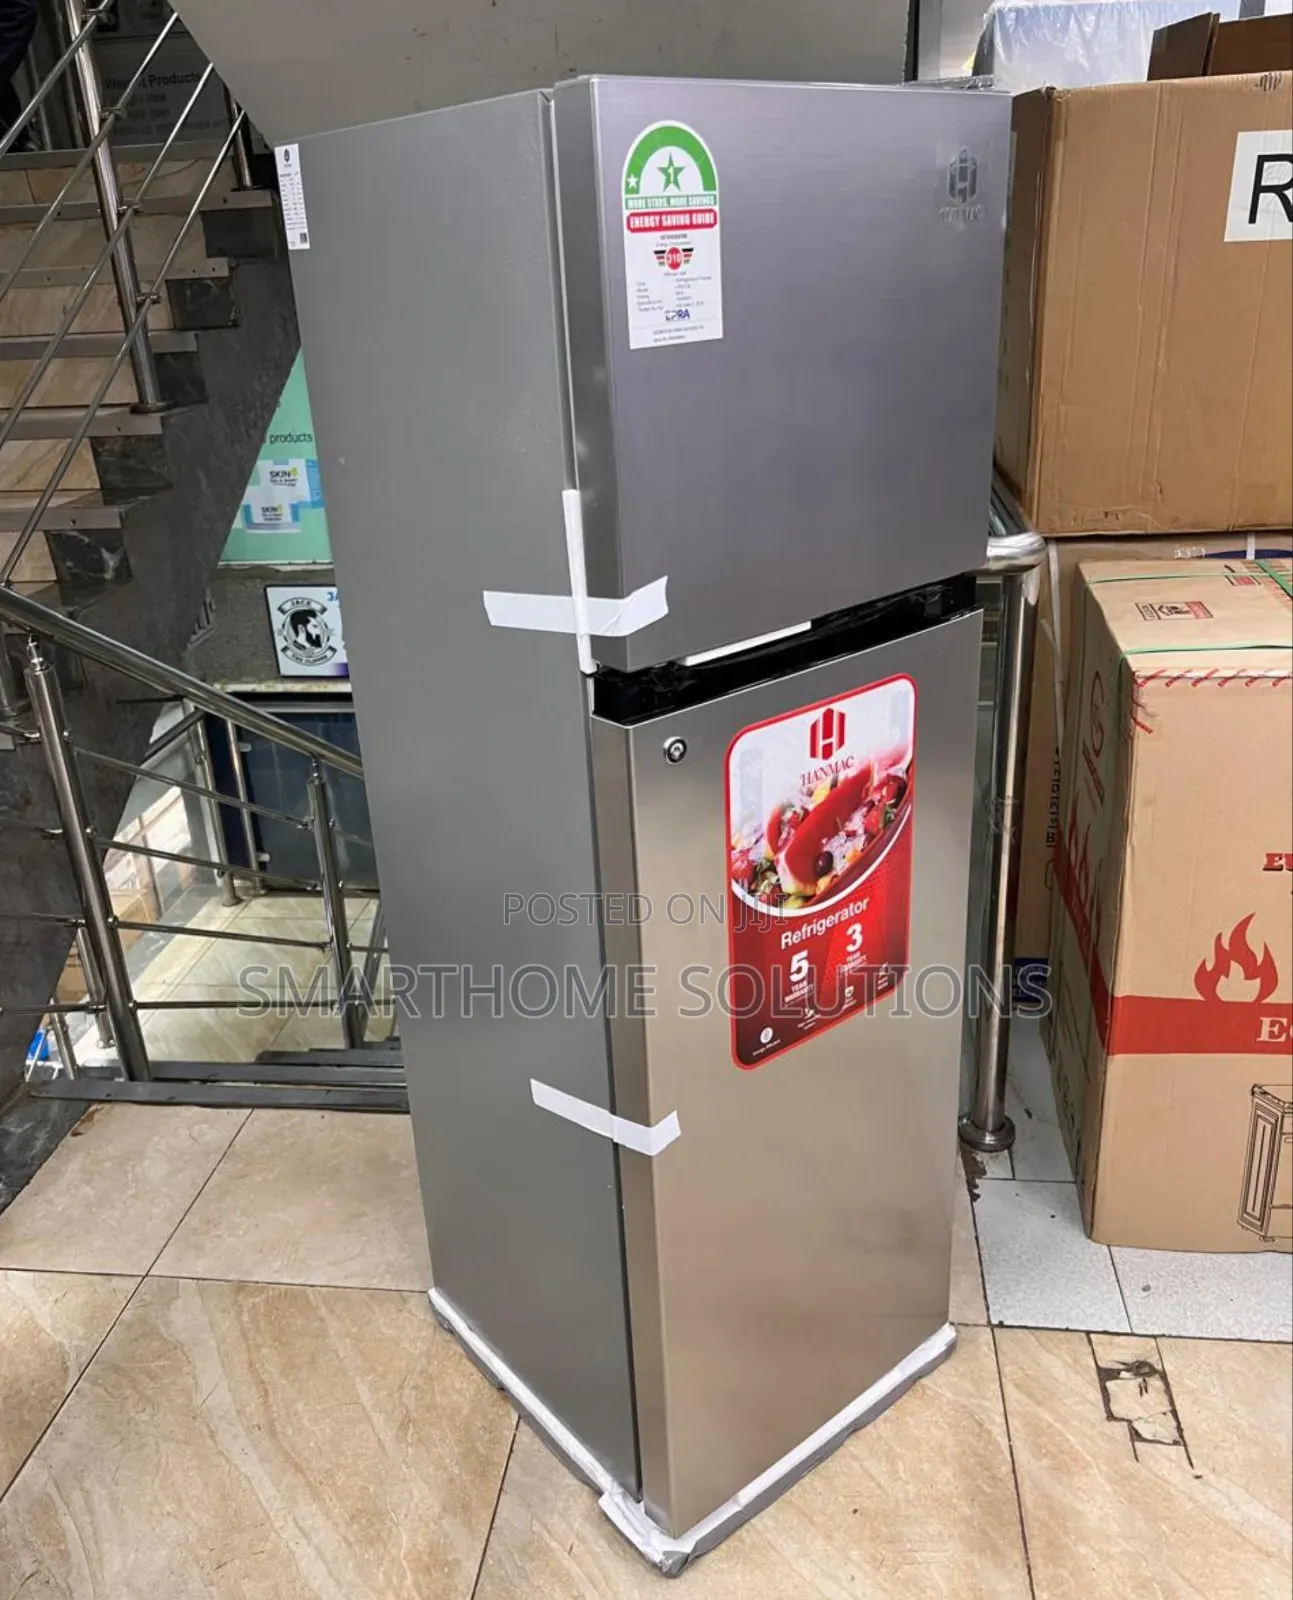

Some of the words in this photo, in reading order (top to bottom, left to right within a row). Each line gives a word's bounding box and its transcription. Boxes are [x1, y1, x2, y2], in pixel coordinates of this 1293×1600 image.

[629, 215, 660, 229] ENERGY
[661, 213, 691, 227] SAVING
[691, 212, 715, 225] GUIDE
[269, 433, 313, 446] products
[269, 470, 291, 478] SKIN
[799, 755, 855, 787] HANMAC
[780, 897, 870, 950] Refrigerator
[845, 922, 863, 953] 3
[788, 949, 810, 982] 5
[1256, 1016, 1293, 1042] E
